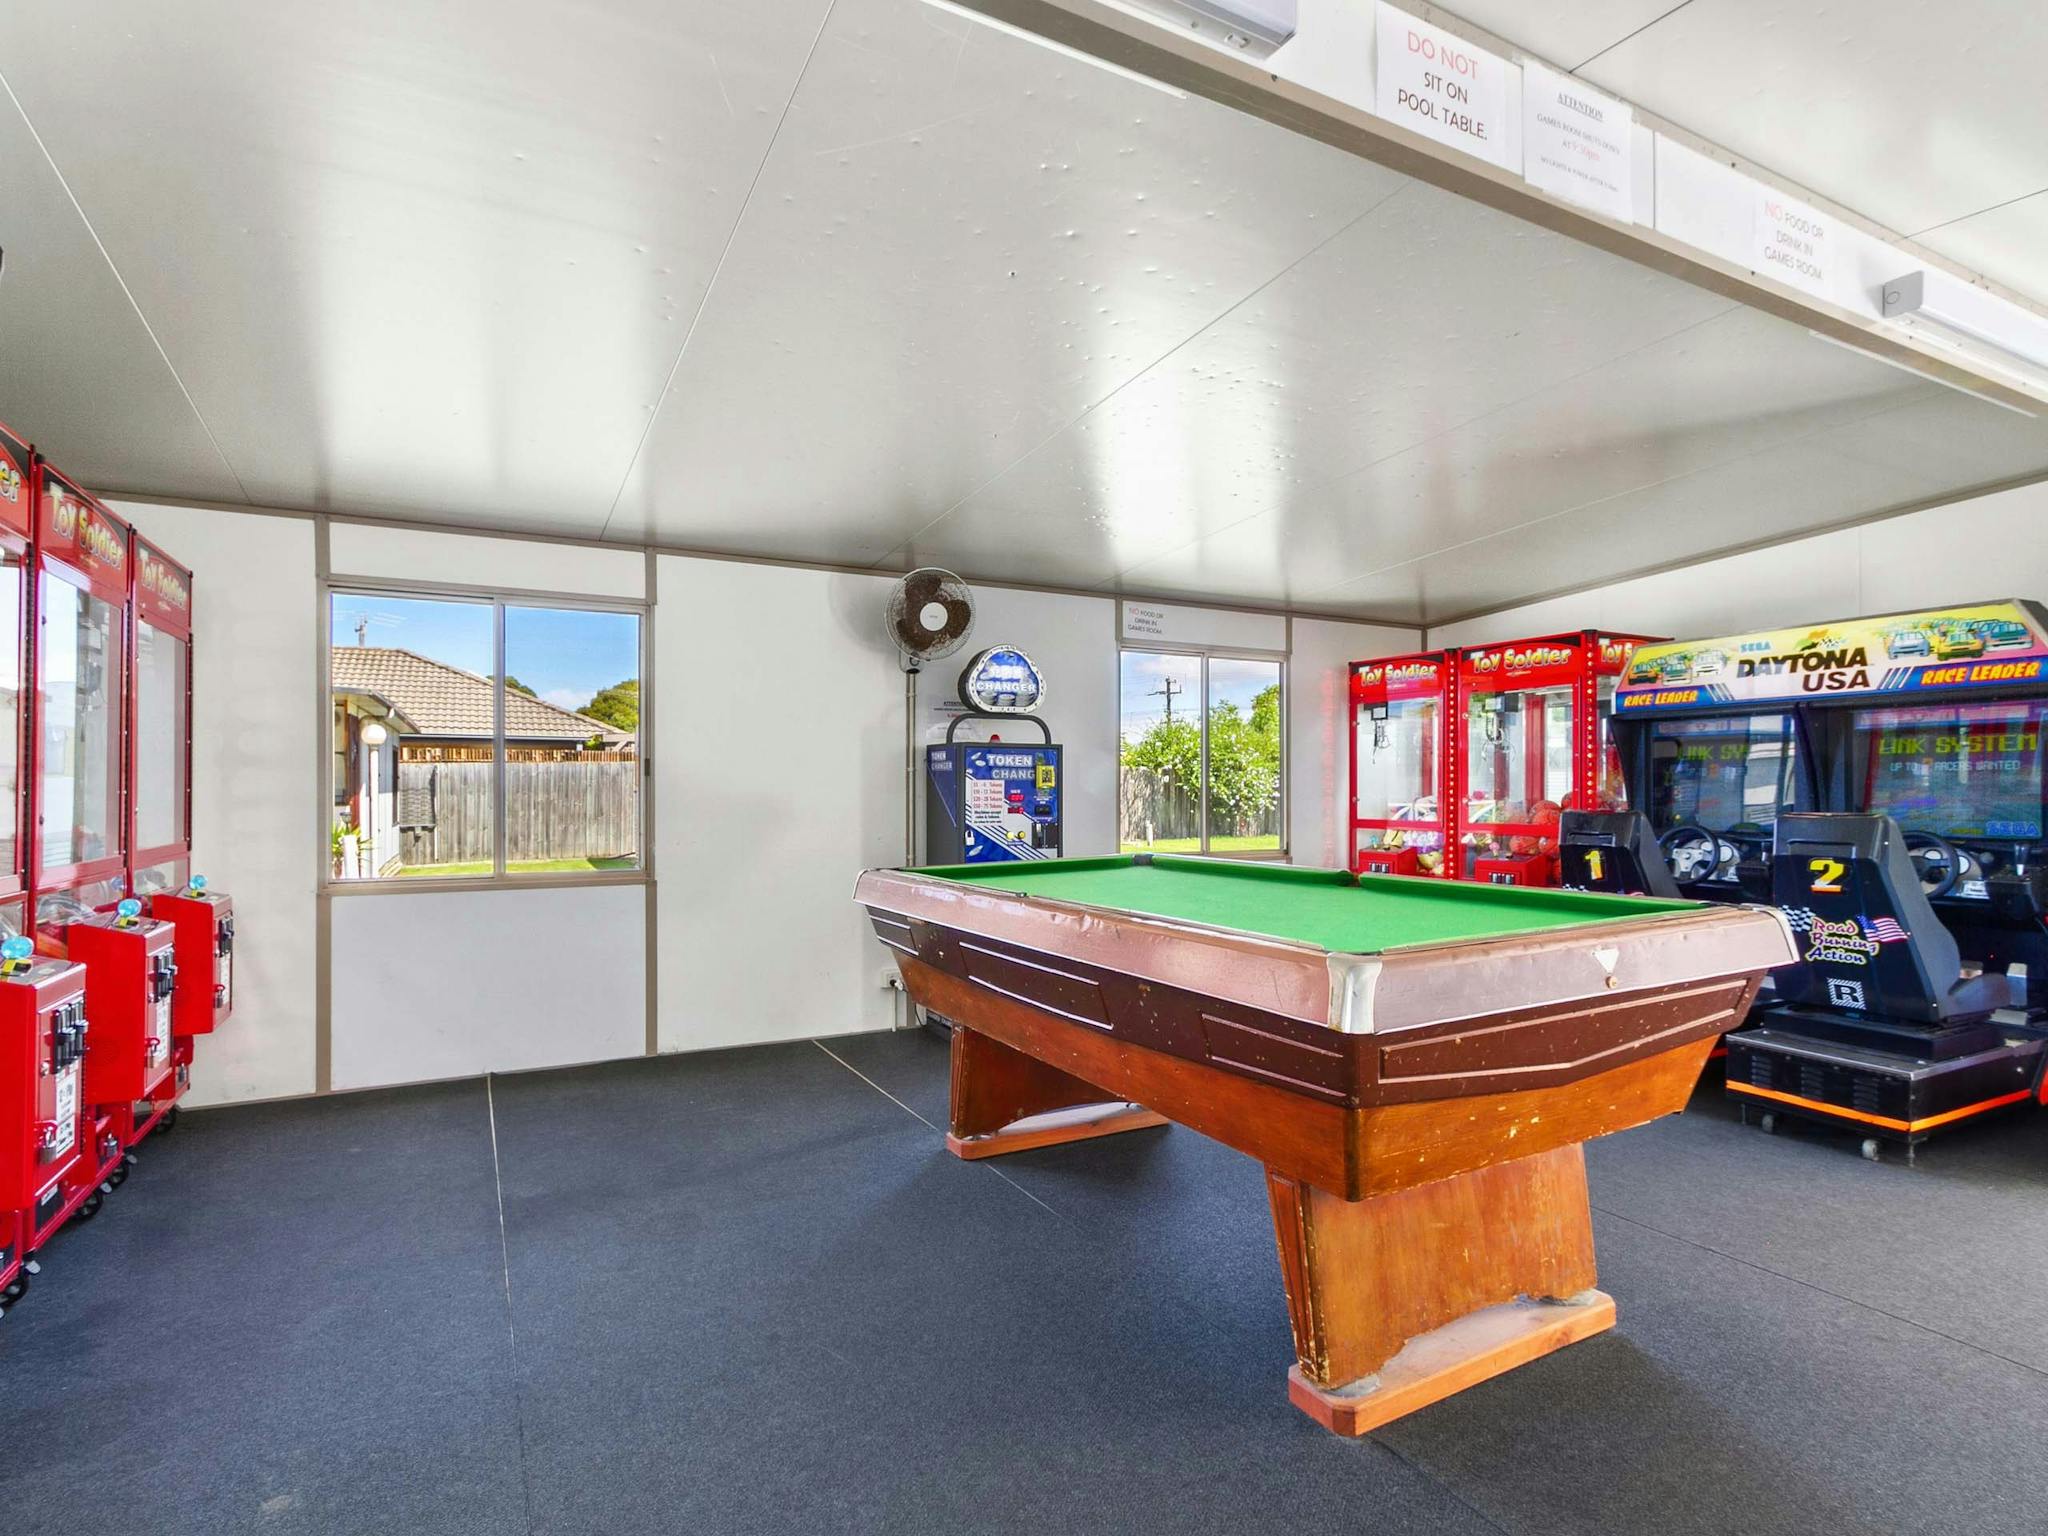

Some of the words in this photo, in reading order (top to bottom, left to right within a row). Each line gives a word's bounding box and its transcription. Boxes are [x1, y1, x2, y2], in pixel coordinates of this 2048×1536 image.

[1407, 30, 1435, 59] DO
[1441, 46, 1478, 80] NOT
[1424, 72, 1442, 92] SIT
[1446, 82, 1468, 104] ON
[1398, 88, 1438, 120] POOL
[1442, 107, 1487, 140] TABLE.
[1557, 92, 1603, 121] ATTENTION
[1765, 200, 1782, 221] NO
[1785, 212, 1809, 234] FOOD
[1811, 225, 1824, 238] OR
[1777, 230, 1802, 251] DRINK
[1764, 246, 1794, 269] GAMES
[50, 481, 77, 540] Toy
[78, 506, 124, 570] Soldier
[139, 548, 158, 591] Toy
[157, 563, 187, 611] Soldier
[1740, 641, 1771, 651] SEGA
[1470, 651, 1502, 673] Toy
[1504, 647, 1572, 670] Soldier
[1736, 647, 1868, 678] DAYTONA
[1358, 665, 1383, 687] Toy
[1385, 662, 1438, 682] Soldier
[1803, 671, 1871, 692] USA
[1920, 667, 1968, 686] RACE
[1969, 661, 2041, 682] LEADER
[976, 682, 1036, 692] CHANGER
[1624, 693, 1652, 707] RACE
[1654, 690, 1698, 705] LEADER
[1879, 736, 1926, 755] LINK
[1936, 733, 2037, 754] SYSTEM
[986, 754, 1033, 766] TOKEN
[992, 768, 1035, 779] CHANG
[1986, 821, 2039, 836] SEGA
[1584, 850, 1604, 881] 1
[1808, 859, 1845, 893] 2
[1812, 917, 1858, 934] Road
[1806, 946, 1866, 964] Action
[1811, 932, 1879, 955] Burning
